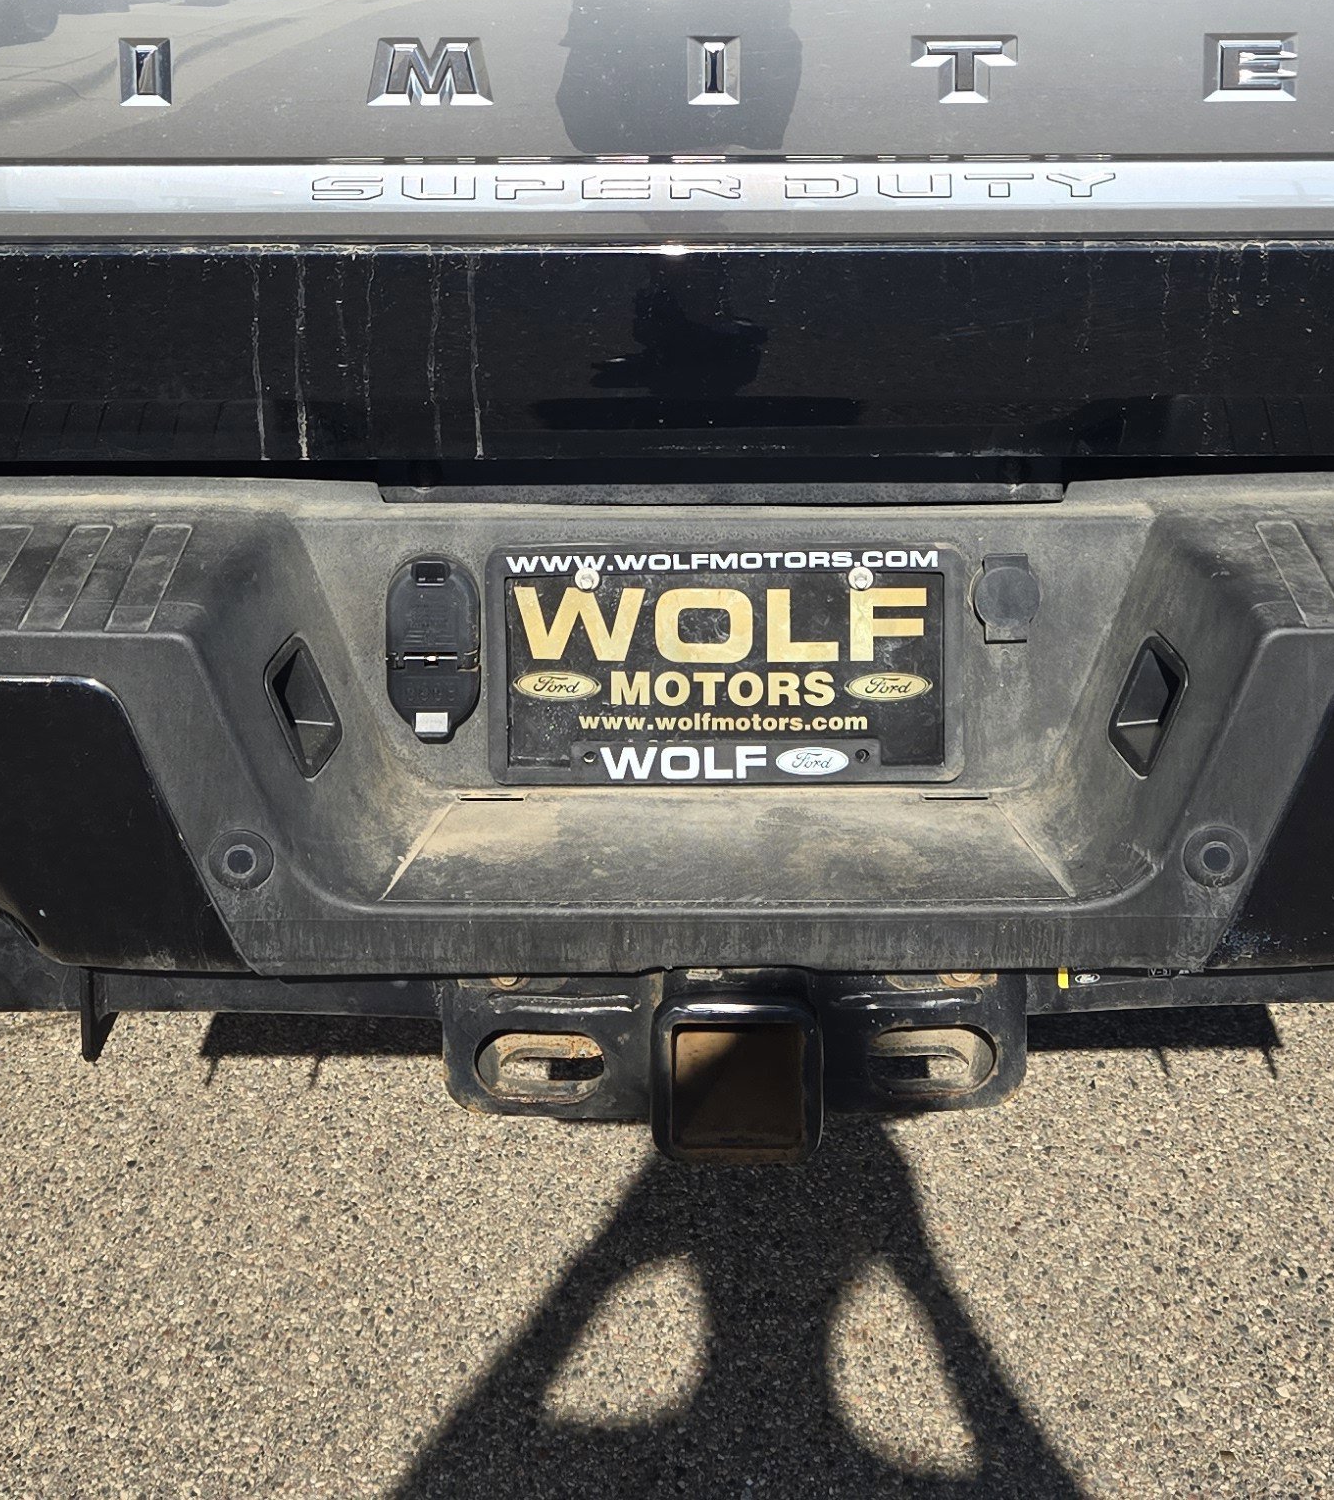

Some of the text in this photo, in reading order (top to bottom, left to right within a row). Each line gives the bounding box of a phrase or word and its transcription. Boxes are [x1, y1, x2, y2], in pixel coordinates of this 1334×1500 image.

[312, 173, 1116, 200] SUPER DUTY
[505, 550, 939, 573] WWW.WOLFMOTORS.COM
[513, 587, 927, 664] WOLF
[610, 671, 836, 707] MOTORS
[578, 713, 868, 731] www.wolfmotors.com
[599, 746, 767, 780] WOLF
